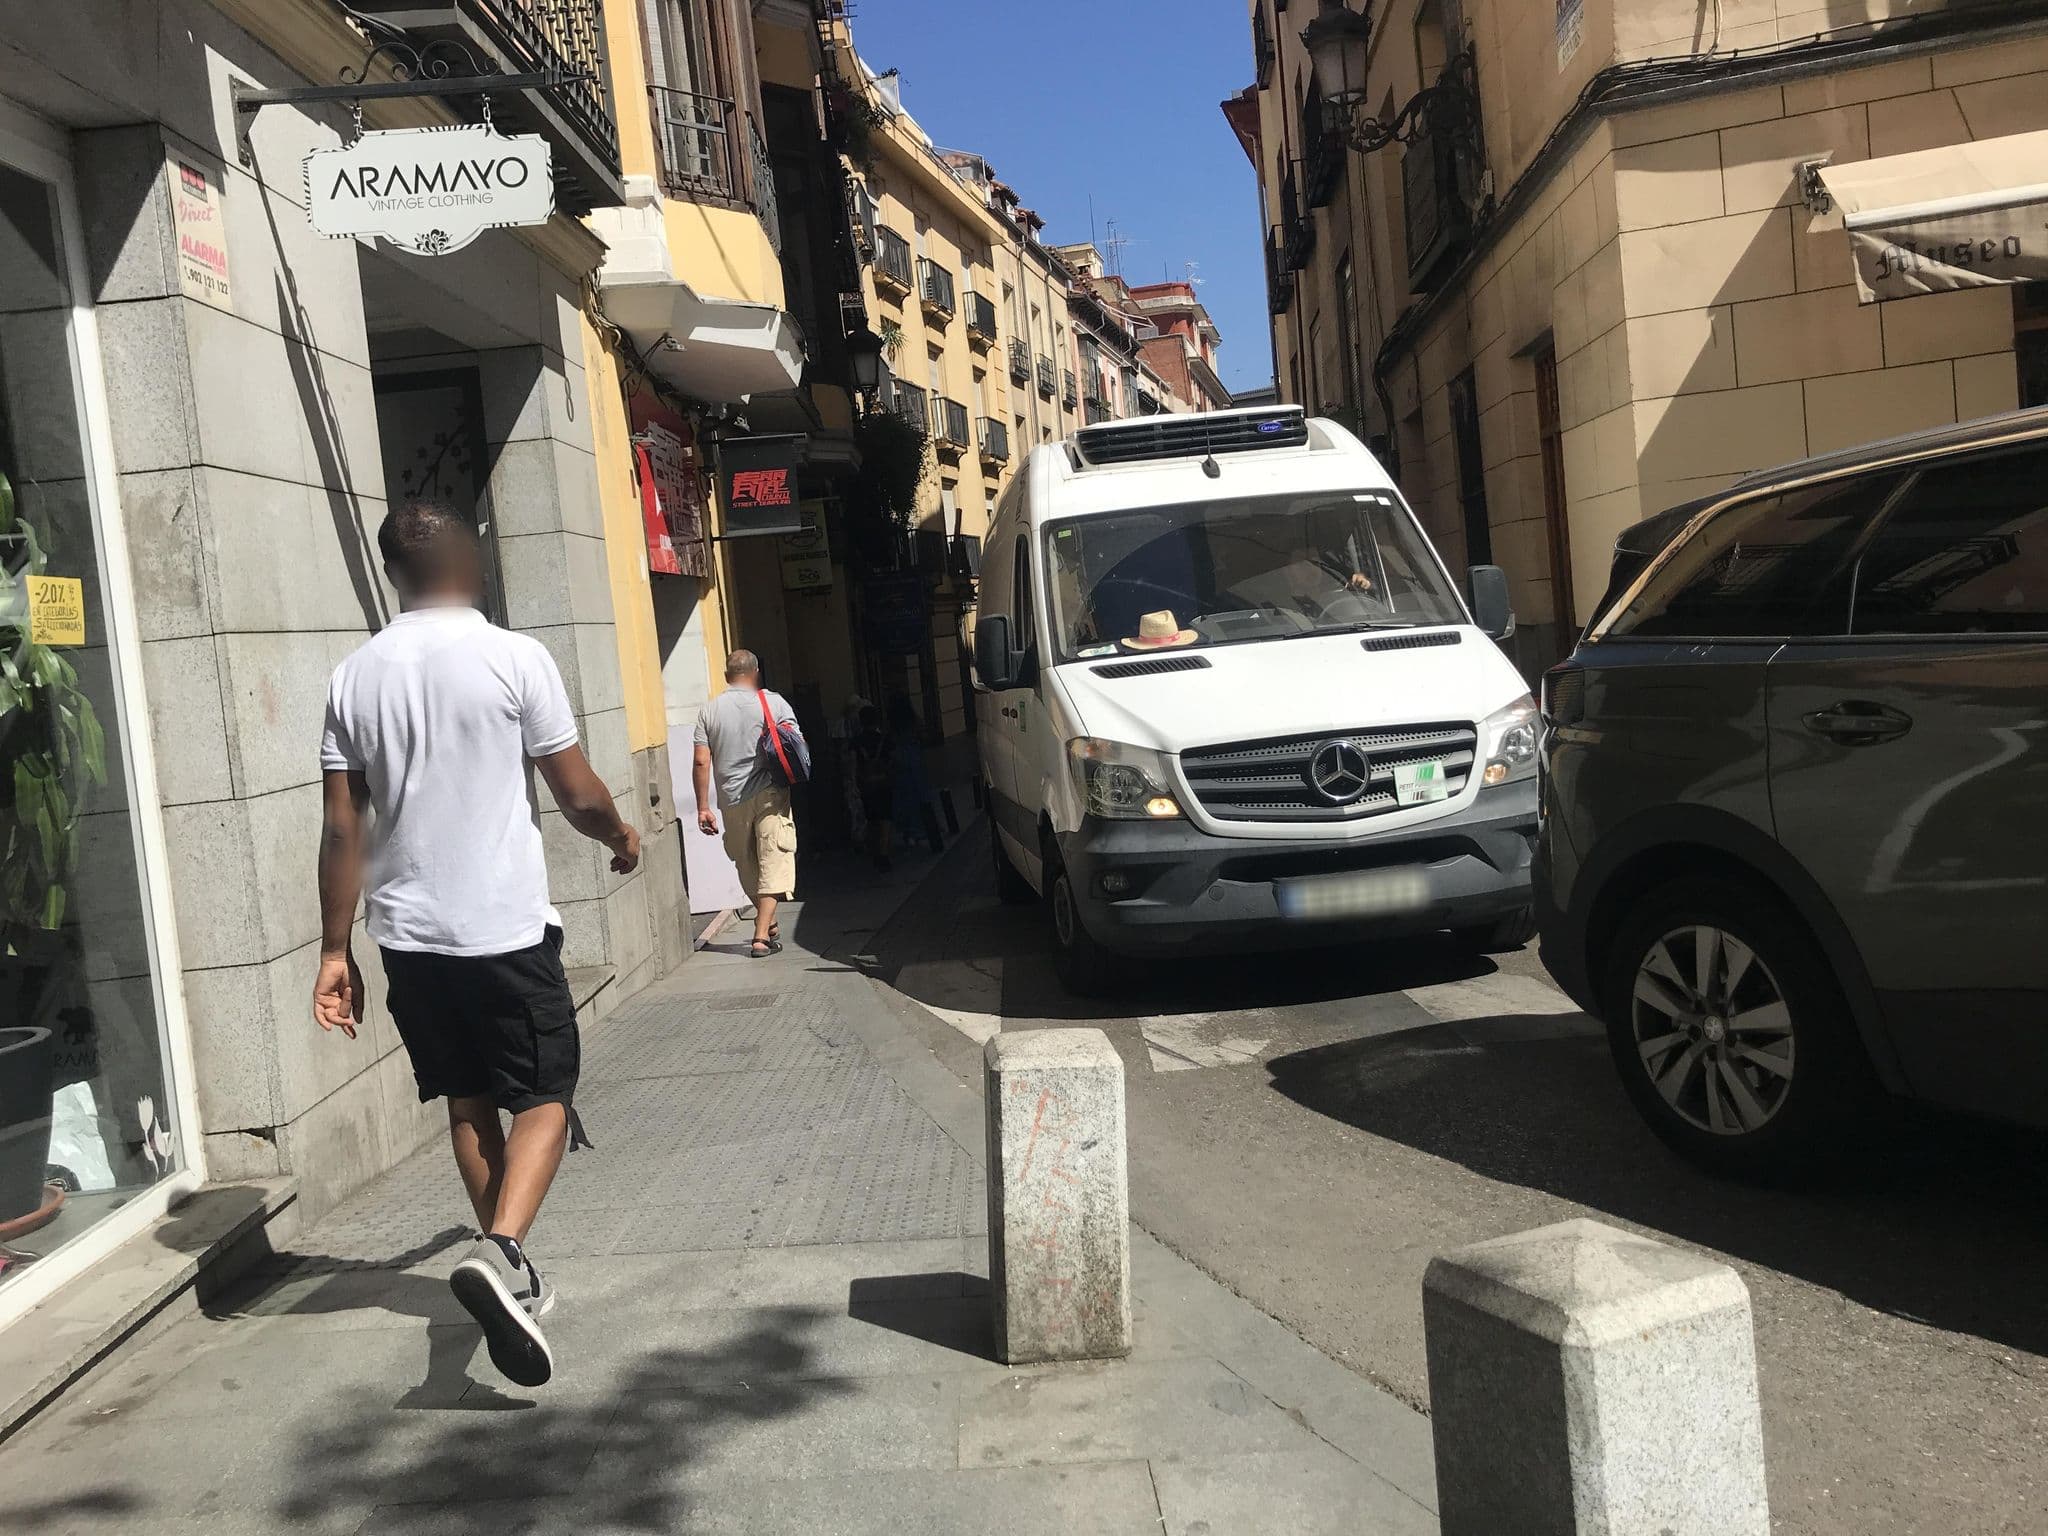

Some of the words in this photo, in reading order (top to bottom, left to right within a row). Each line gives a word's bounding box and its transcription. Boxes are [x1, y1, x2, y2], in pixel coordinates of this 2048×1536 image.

[330, 156, 528, 200] ARAMAYO
[179, 198, 214, 222] Direct
[368, 196, 424, 211] VINTAGE
[429, 193, 494, 207] CLOTHING
[182, 235, 226, 268] ALARMA
[1876, 233, 2021, 280] Museo
[190, 268, 202, 284] 902
[204, 275, 215, 289] 121
[217, 280, 228, 295] 122
[35, 582, 65, 604] -20%
